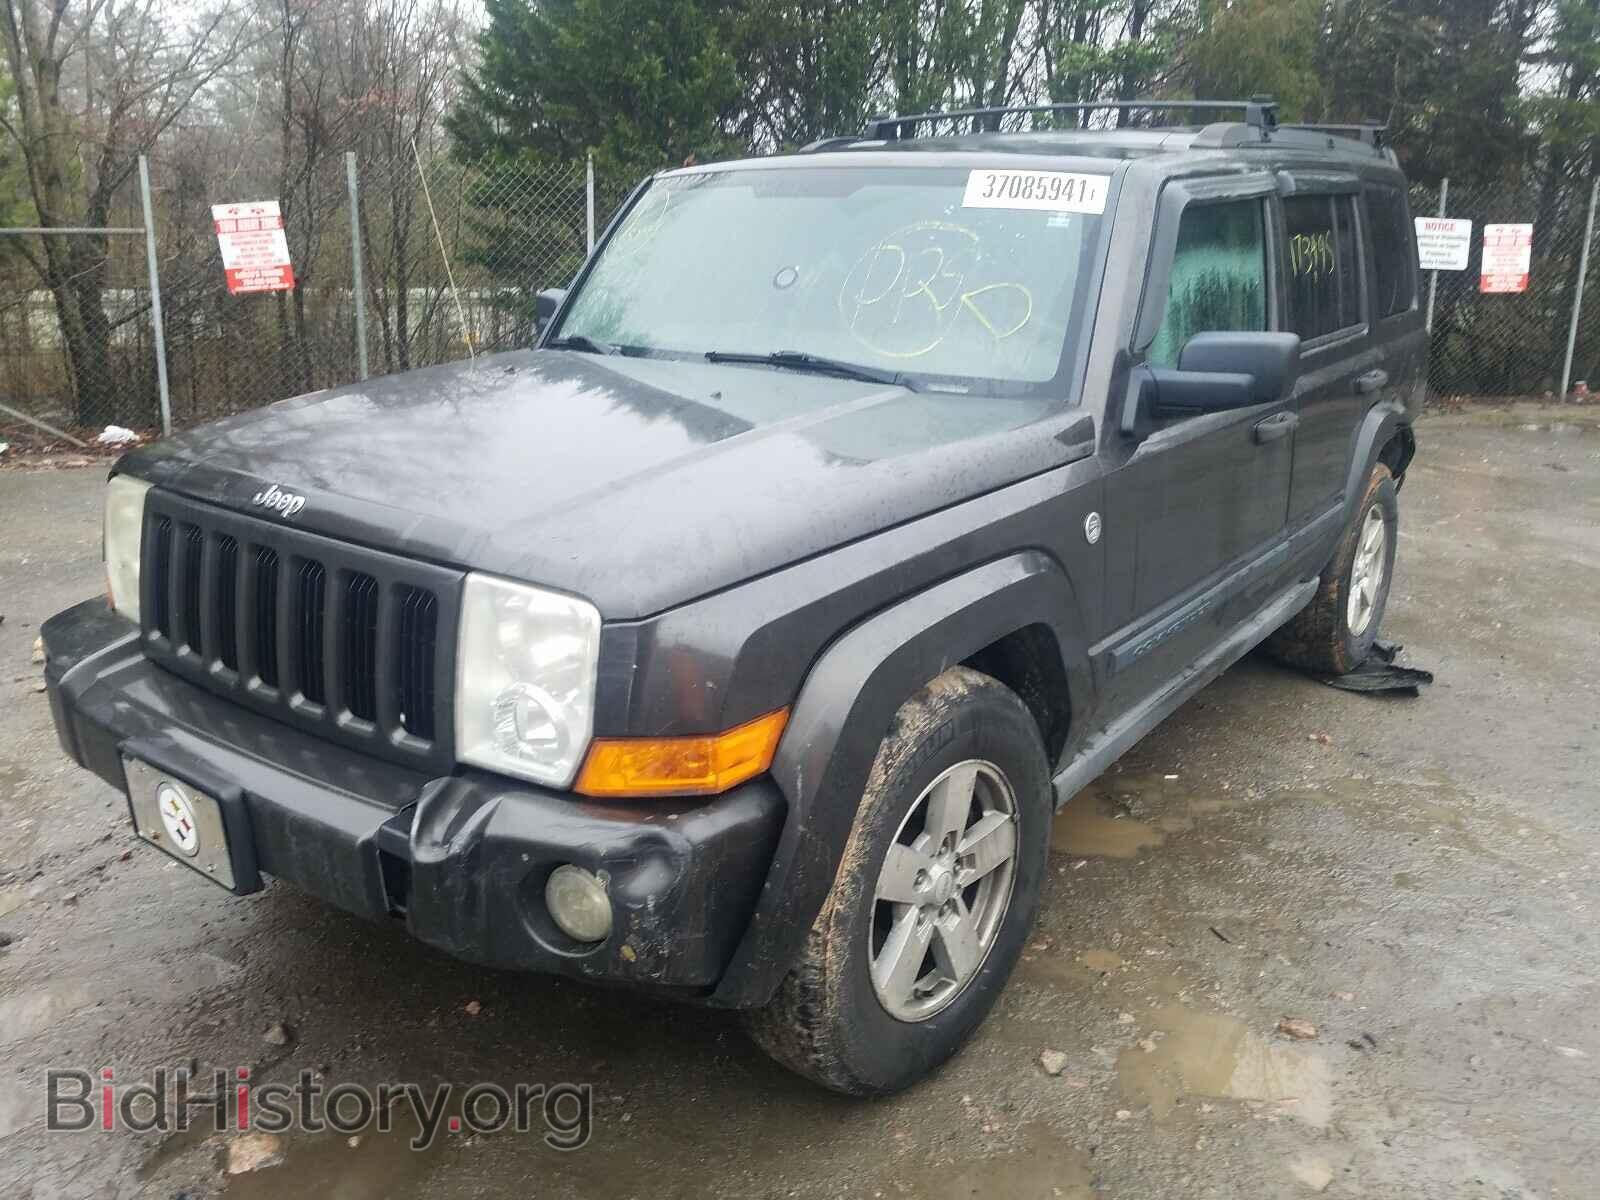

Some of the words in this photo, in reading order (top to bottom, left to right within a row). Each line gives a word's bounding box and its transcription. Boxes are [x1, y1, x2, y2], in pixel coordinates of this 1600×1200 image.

[982, 174, 1087, 202] 37085941
[1424, 222, 1456, 232] NOTICE
[253, 484, 305, 518] Jeep
